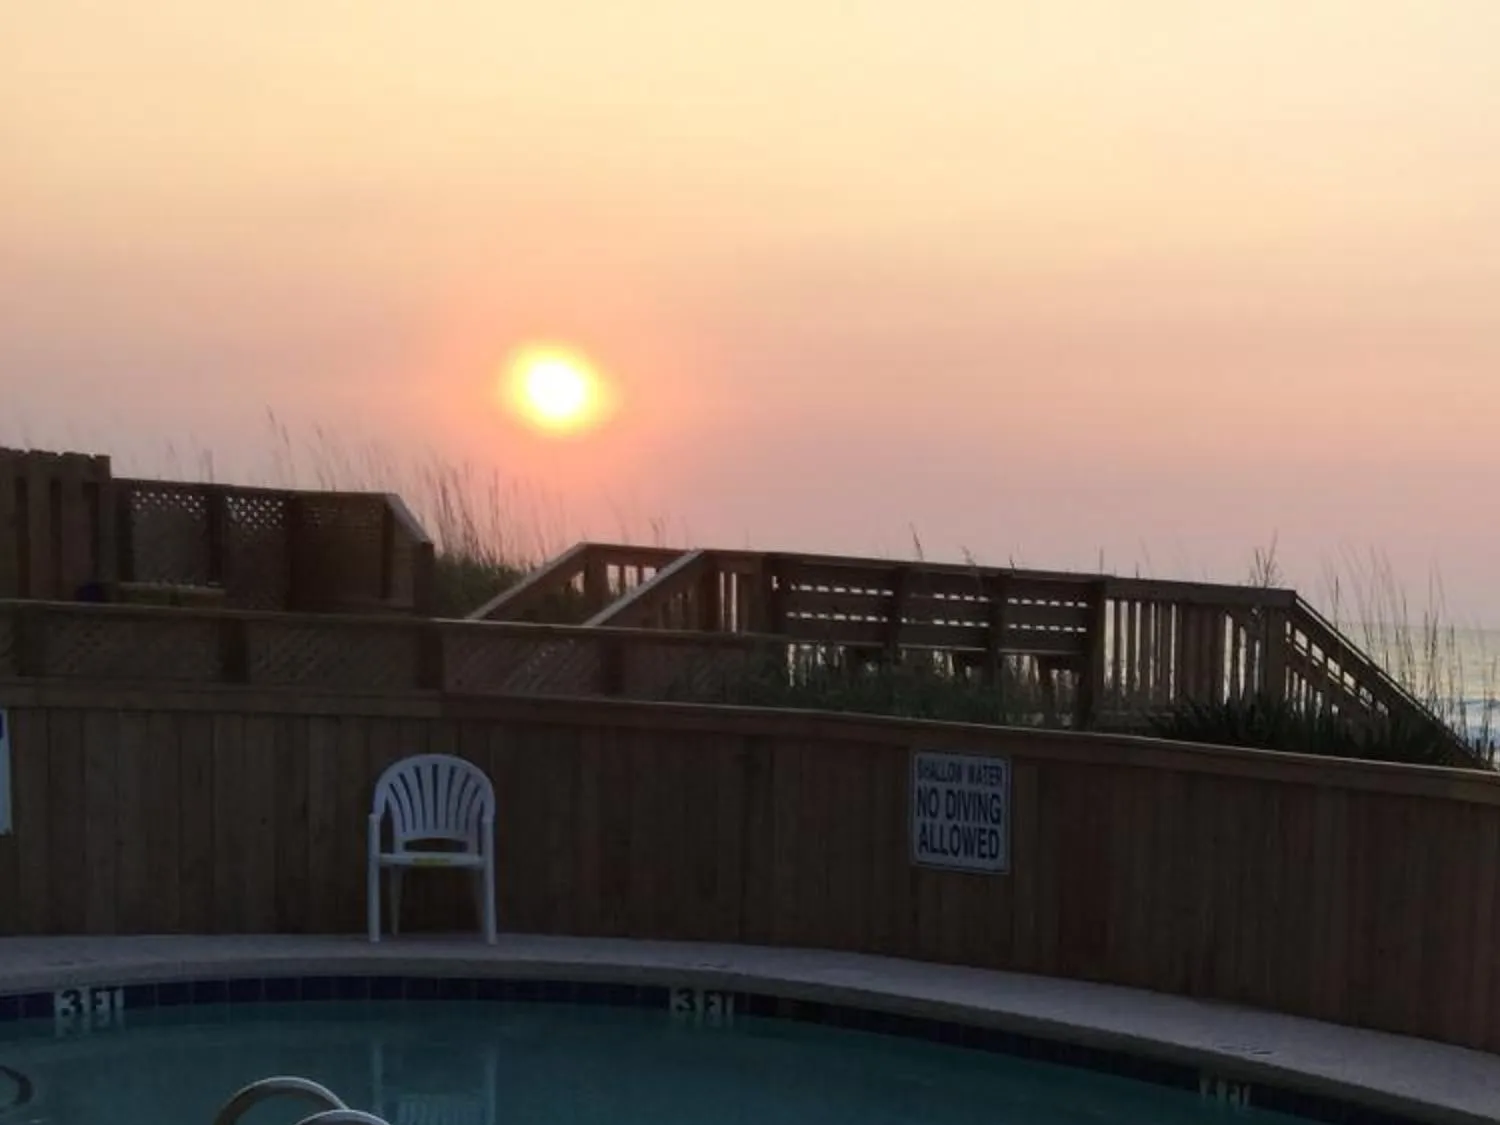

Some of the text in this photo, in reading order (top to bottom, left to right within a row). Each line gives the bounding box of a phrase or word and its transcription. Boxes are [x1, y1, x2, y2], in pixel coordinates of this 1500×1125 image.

[917, 785, 1002, 826] NO DIVING
[919, 823, 999, 859] ALLOWED
